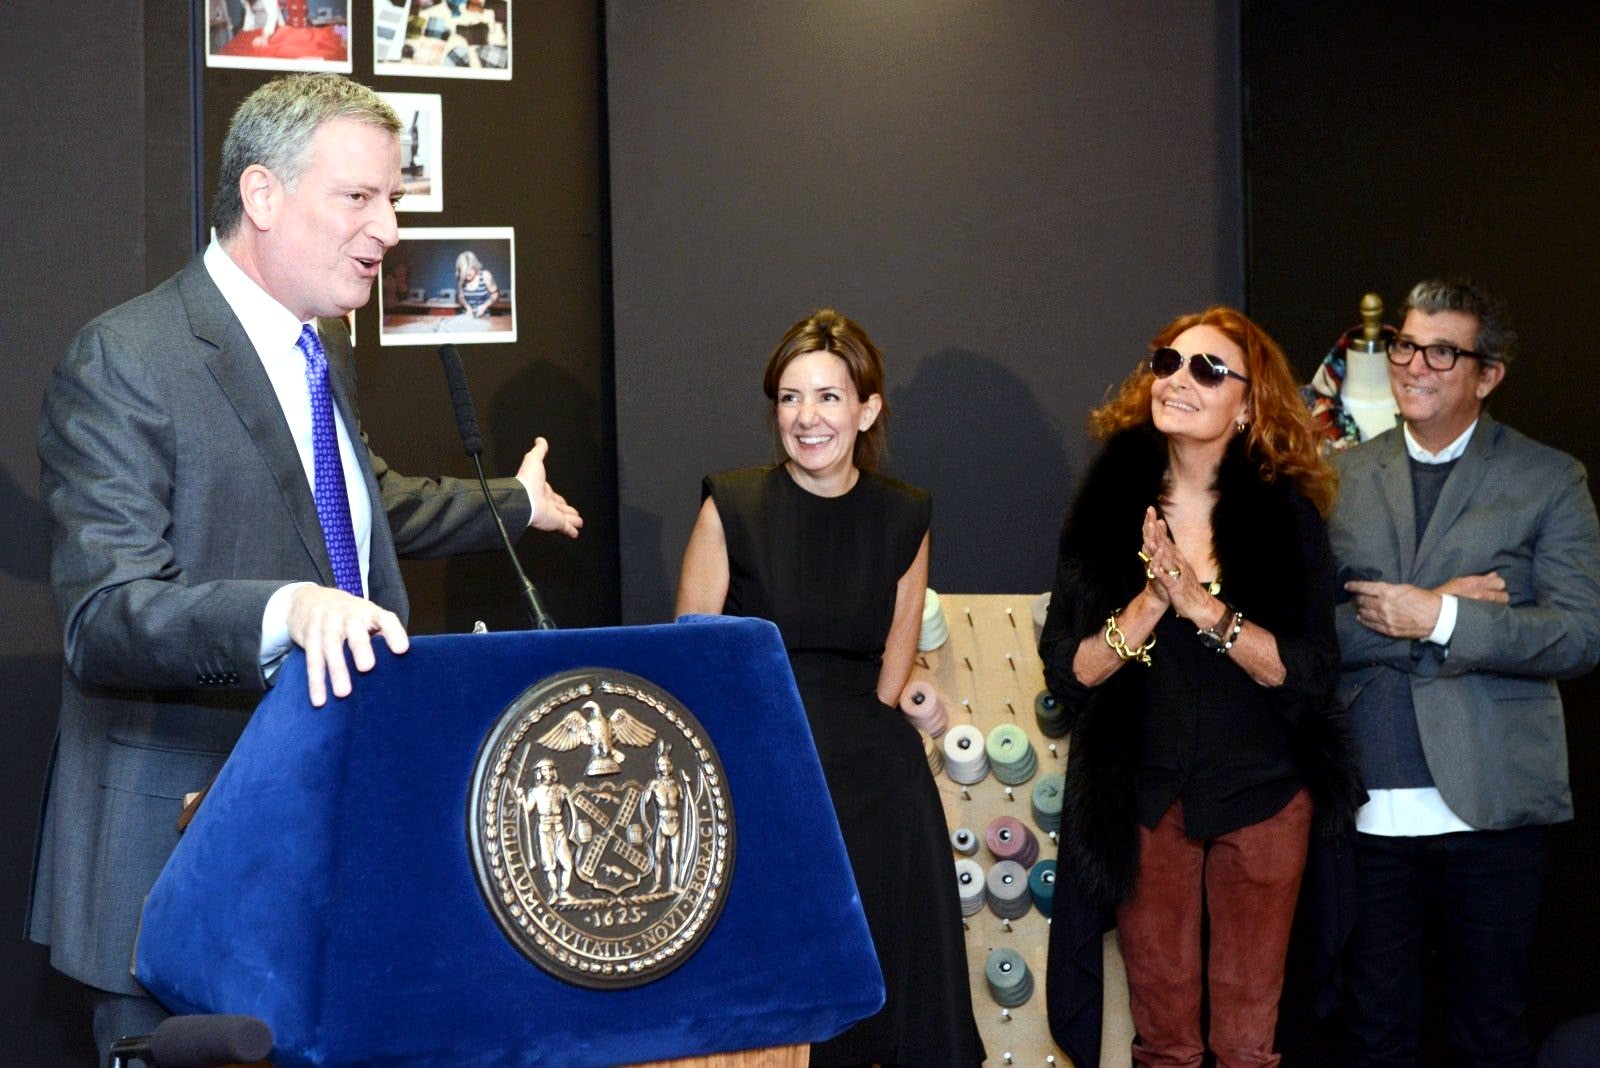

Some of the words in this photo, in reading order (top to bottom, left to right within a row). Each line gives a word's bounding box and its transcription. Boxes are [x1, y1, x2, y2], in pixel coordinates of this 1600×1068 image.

[503, 806, 540, 910] SIGILLUM
[541, 913, 633, 957] CIVITATIS
[641, 907, 688, 950] NOVI
[684, 817, 714, 906] EBORACI
